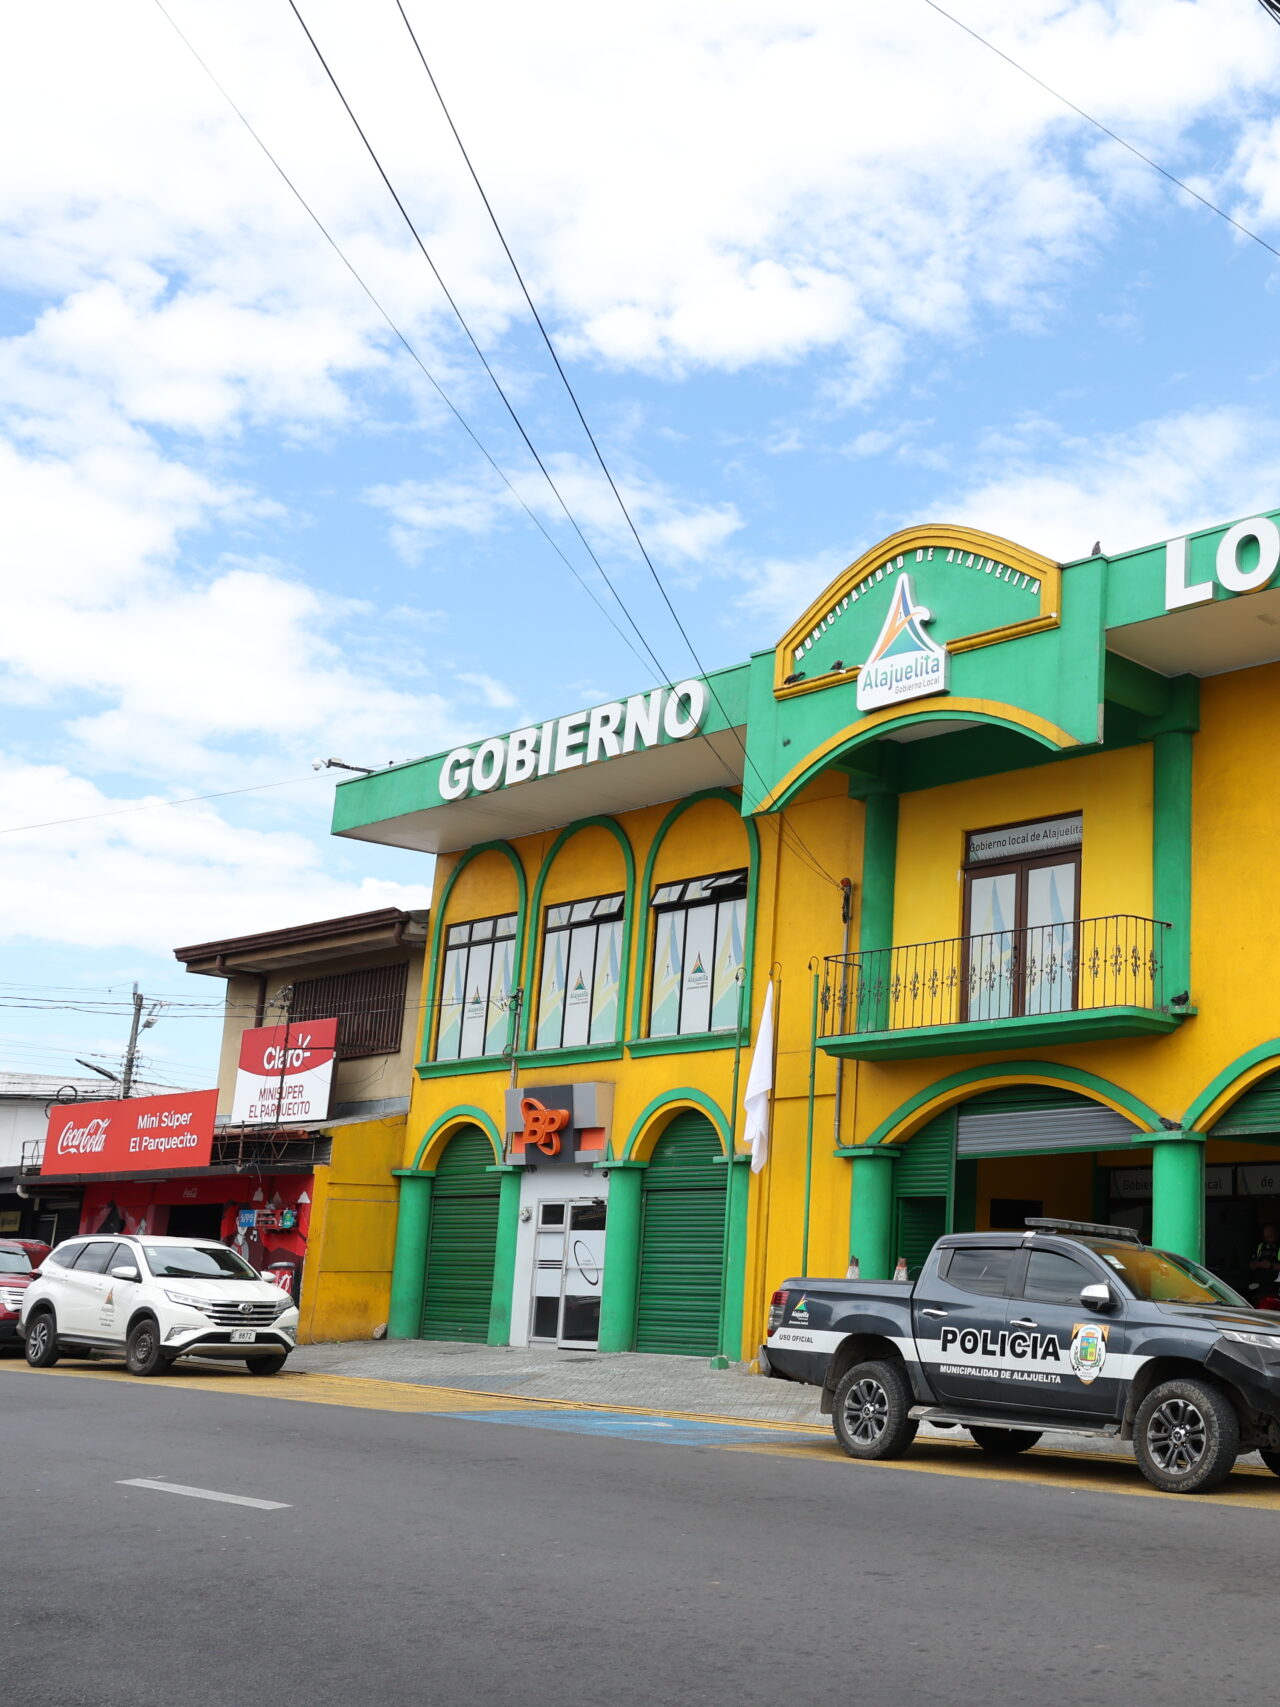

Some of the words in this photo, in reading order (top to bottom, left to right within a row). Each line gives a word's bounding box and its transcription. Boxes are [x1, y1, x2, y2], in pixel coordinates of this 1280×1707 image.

[794, 555, 904, 661] MUNICIPALIDAD
[916, 548, 934, 562] DE
[946, 549, 1042, 595] ALAJUELITA
[862, 653, 940, 691] Alajuelita
[894, 681, 922, 695] Gobierno
[922, 676, 940, 688] Local
[438, 679, 708, 801] GOBIERNO
[970, 840, 1007, 853] Gobierno
[1008, 834, 1029, 846] local
[1031, 832, 1041, 842] de
[1042, 824, 1083, 840] Alajuelita
[263, 1045, 304, 1071] Claro
[137, 1112, 160, 1129] Mini
[161, 1109, 193, 1130] Súper
[248, 1104, 258, 1118] EL
[129, 1137, 139, 1152] El
[142, 1132, 198, 1152] Parquecito
[1260, 1175, 1274, 1188] de
[792, 1335, 814, 1343] OFICIAL
[940, 1326, 1061, 1361] POLICIA
[940, 1364, 999, 1378] MUNICIPALIDAD
[1000, 1370, 1010, 1379] DE
[1012, 1371, 1061, 1383] ALAJUELITA
